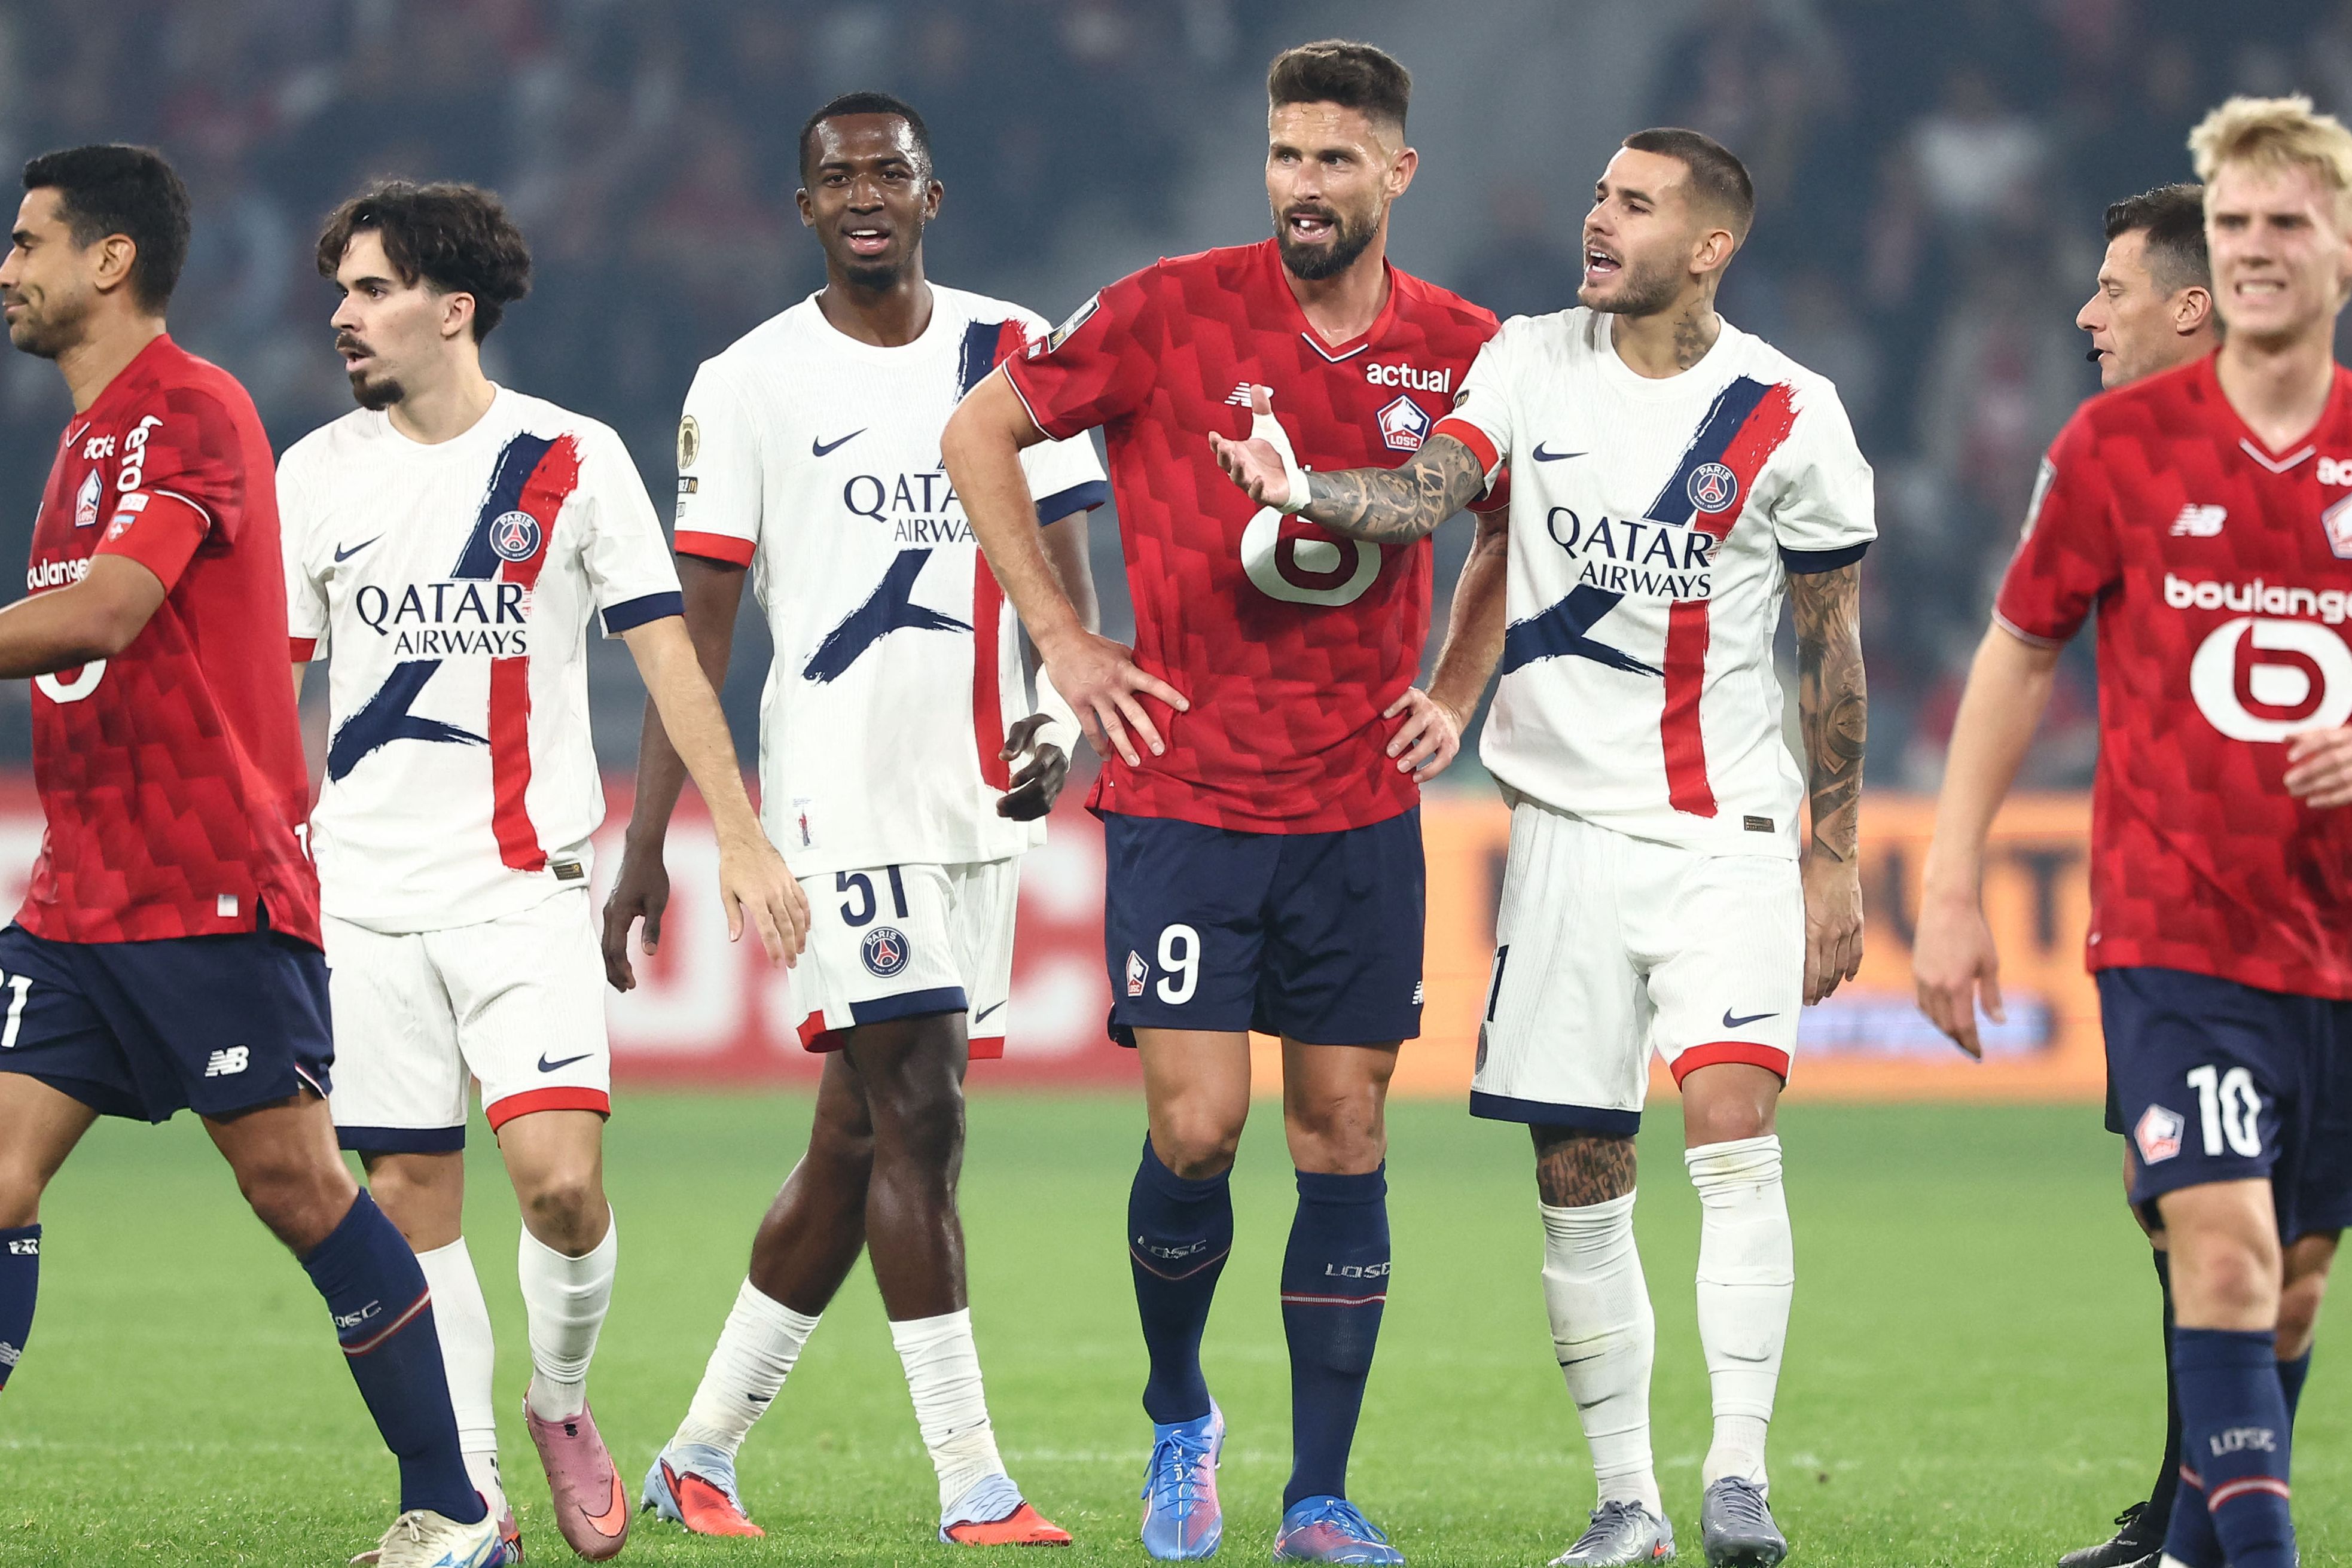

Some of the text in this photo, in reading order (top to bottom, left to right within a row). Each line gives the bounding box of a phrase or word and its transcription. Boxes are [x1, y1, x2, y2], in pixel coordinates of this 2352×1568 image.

[1366, 363, 1451, 393] actual
[1390, 435, 1417, 447] LOSC
[1699, 465, 1731, 480] PARIS
[499, 514, 533, 527] PARIS
[1547, 507, 1713, 569] QATAR
[1579, 560, 1710, 597] AIRWAYS
[356, 583, 526, 636] QATAR
[2164, 572, 2352, 624] boulang
[394, 630, 526, 655] AIRWAYS
[836, 864, 908, 927] 51
[866, 931, 897, 945] PARIS
[1157, 924, 1200, 1005] 9
[2187, 1065, 2262, 1157] 10
[1325, 1262, 1391, 1279] LOSC
